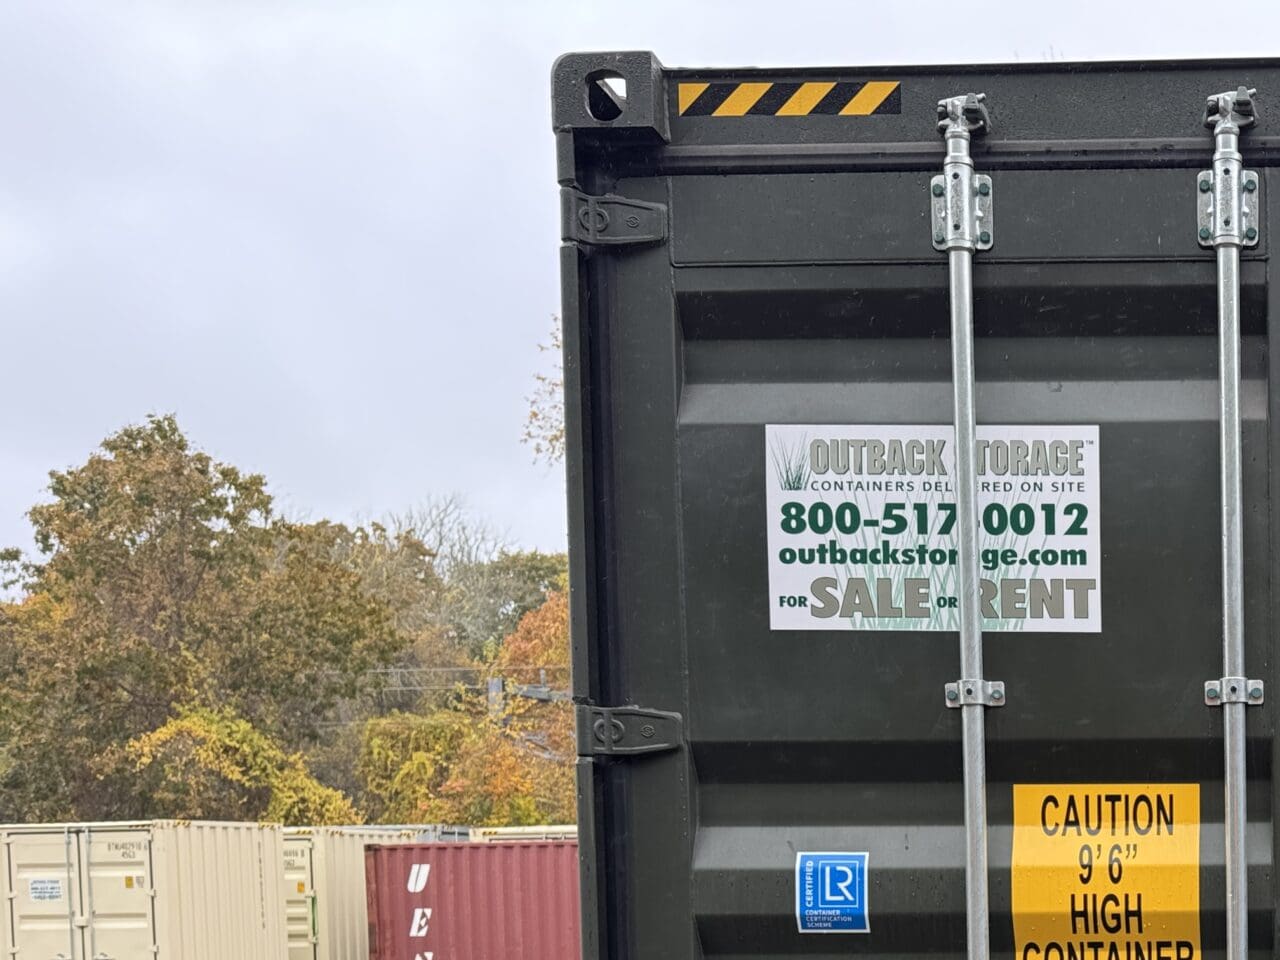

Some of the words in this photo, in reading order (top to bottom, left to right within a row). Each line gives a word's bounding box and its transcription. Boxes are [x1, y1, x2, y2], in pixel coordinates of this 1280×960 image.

[808, 439, 948, 476] OUTBACK
[954, 439, 1085, 477] TORAGE
[811, 481, 914, 492] CONTAINERS
[923, 481, 1013, 493] DELRED
[1021, 481, 1044, 492] ON
[1051, 481, 1085, 492] SITE
[780, 501, 1089, 536] 800-5170012
[779, 540, 1087, 571] outbackstorge.com
[779, 595, 808, 608] FOR
[810, 576, 931, 619] SALE
[936, 595, 958, 608] OR
[1040, 793, 1175, 837] CAUTION
[805, 860, 814, 907] CERTIFIED
[825, 866, 855, 901] LR
[1070, 892, 1144, 935] HIGH
